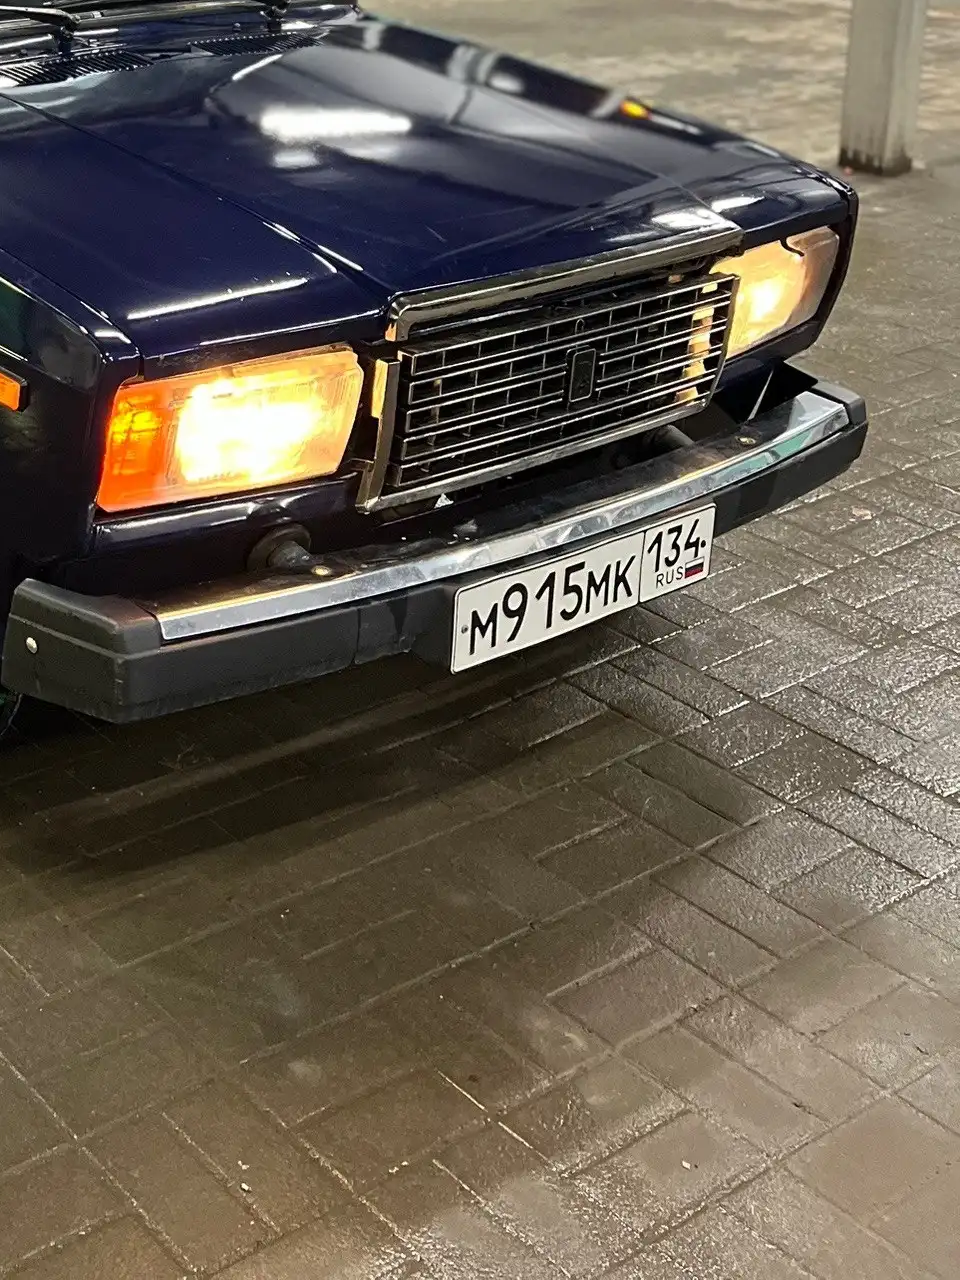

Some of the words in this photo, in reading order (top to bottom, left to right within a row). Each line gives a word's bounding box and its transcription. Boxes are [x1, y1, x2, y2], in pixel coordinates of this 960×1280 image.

[469, 555, 636, 656] М915МК
[647, 518, 701, 573] 134
[656, 566, 684, 589] RUS
